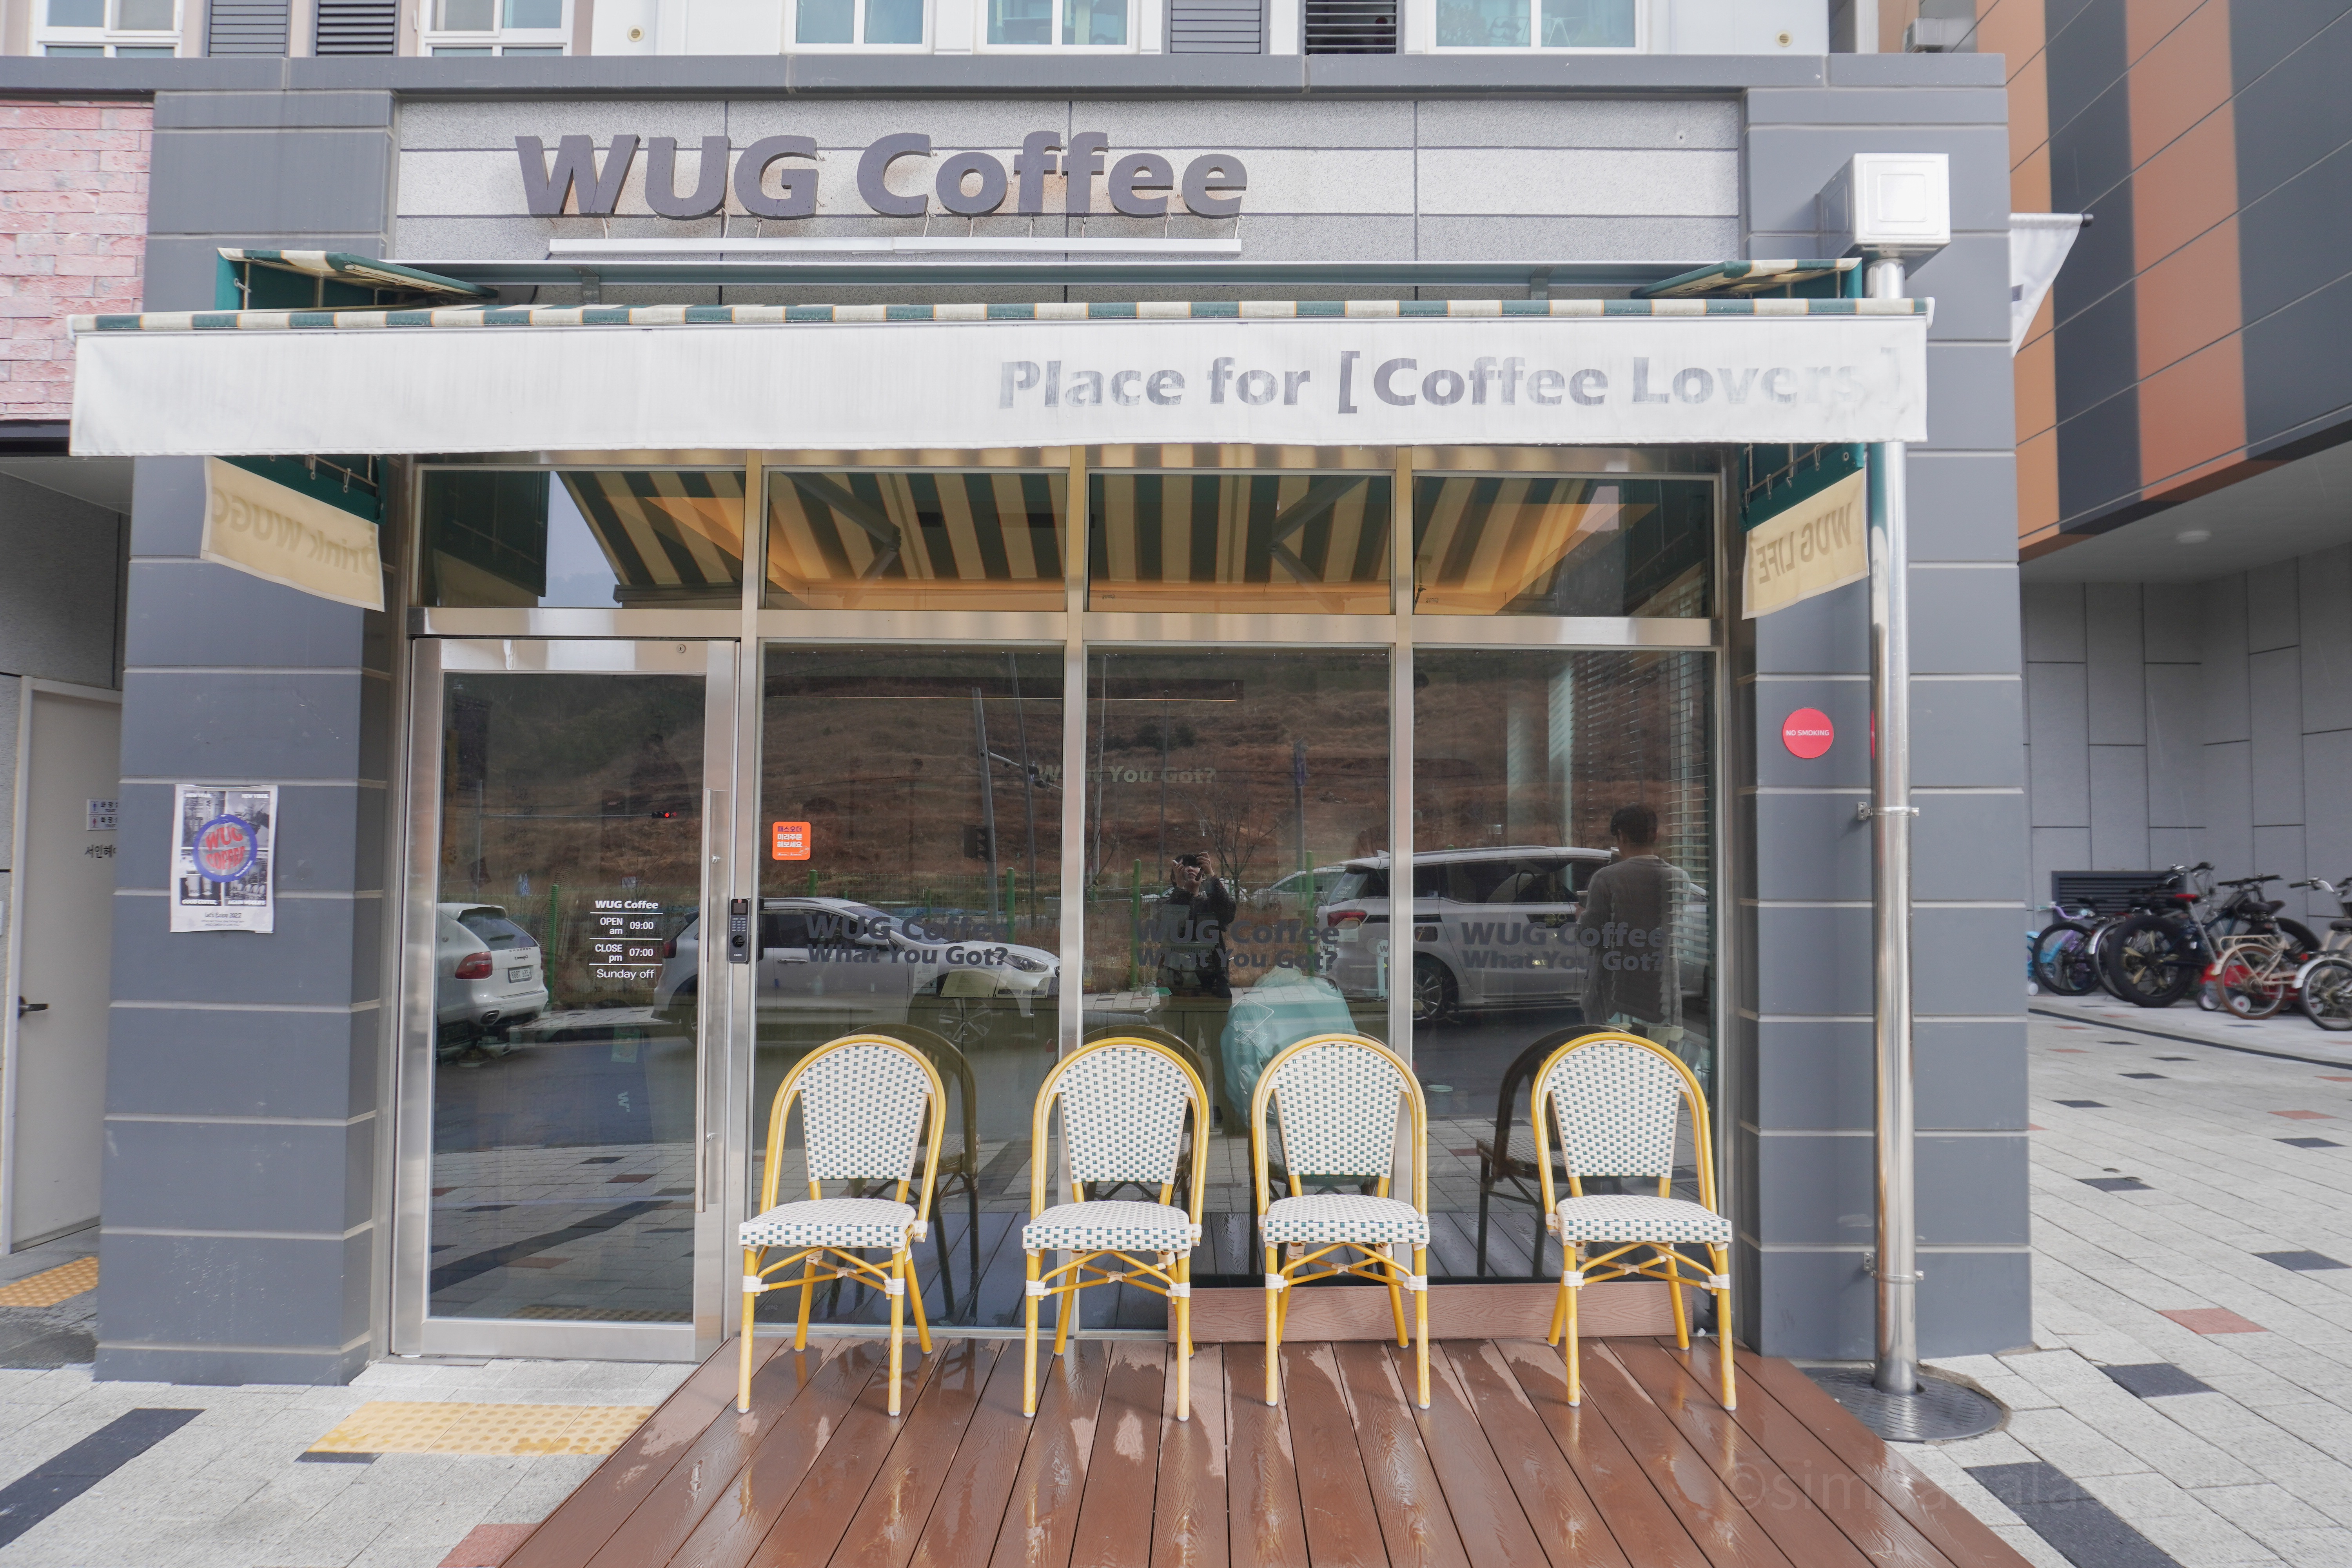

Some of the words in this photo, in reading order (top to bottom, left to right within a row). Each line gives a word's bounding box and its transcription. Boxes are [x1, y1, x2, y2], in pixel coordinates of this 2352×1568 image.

[514, 134, 819, 220] WUG
[857, 130, 1248, 219] Coffee
[999, 360, 1185, 408] Place
[1207, 357, 1310, 405] for
[1109, 766, 1153, 783] You
[1160, 767, 1216, 784] Got?
[205, 826, 243, 851] WUG
[206, 846, 245, 870] COFFEE
[595, 900, 622, 909] WUG
[624, 900, 659, 909] Coffee
[600, 917, 623, 926] OPEN
[805, 915, 890, 940] WUG
[902, 915, 1010, 941] Coffee
[1137, 919, 1220, 944] WUG
[1230, 919, 1340, 944] Coffee
[1461, 922, 1548, 946] WUG
[1557, 922, 1667, 947] Coffee
[595, 944, 623, 952] CLOSE
[609, 955, 622, 963] pm
[629, 948, 653, 956] 07:00
[808, 944, 880, 963] What
[886, 945, 937, 965] You
[945, 946, 1008, 966] Got?
[1137, 947, 1209, 967] What
[1216, 949, 1267, 968] You
[1276, 949, 1338, 970] Got?
[1461, 950, 1537, 969] What
[1543, 951, 1594, 970] You
[1602, 951, 1664, 971] Got?
[597, 969, 637, 980] Sunday
[639, 969, 655, 978] off
